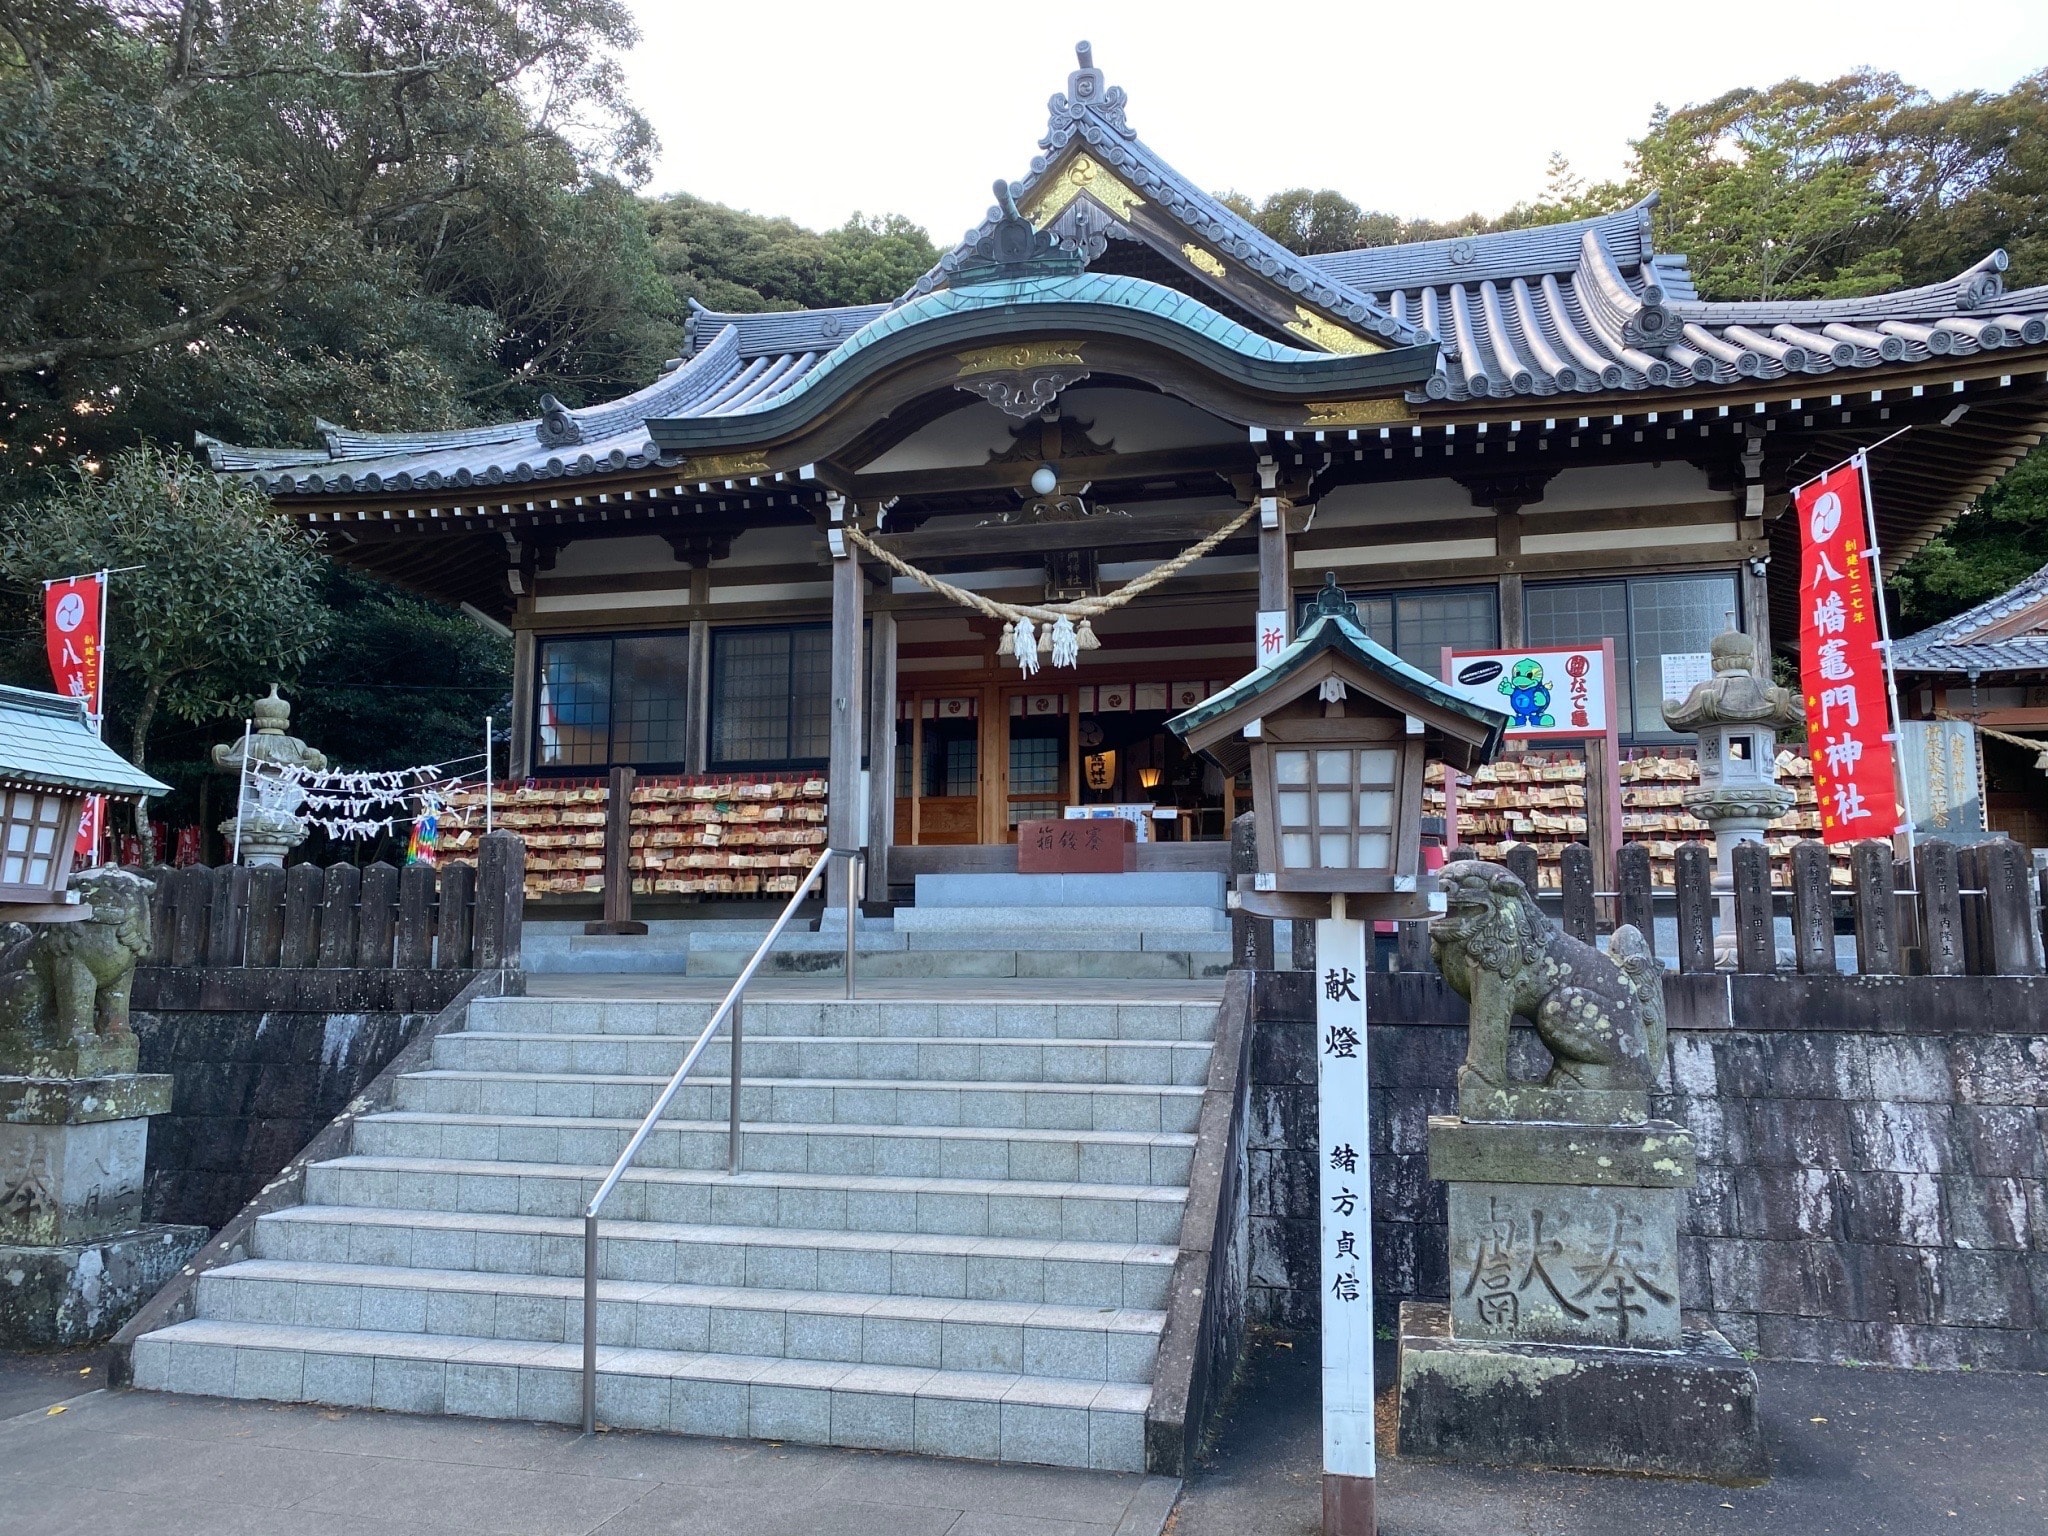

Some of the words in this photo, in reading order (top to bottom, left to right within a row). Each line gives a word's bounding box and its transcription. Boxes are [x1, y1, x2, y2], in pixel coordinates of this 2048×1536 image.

[1844, 539, 1865, 624] 創建七二七年
[1262, 627, 1285, 654] 祈
[1812, 550, 1872, 827] 八幡竈門神社
[1324, 967, 1360, 1058] 献燈
[1330, 1145, 1360, 1303] 緒方貞信
